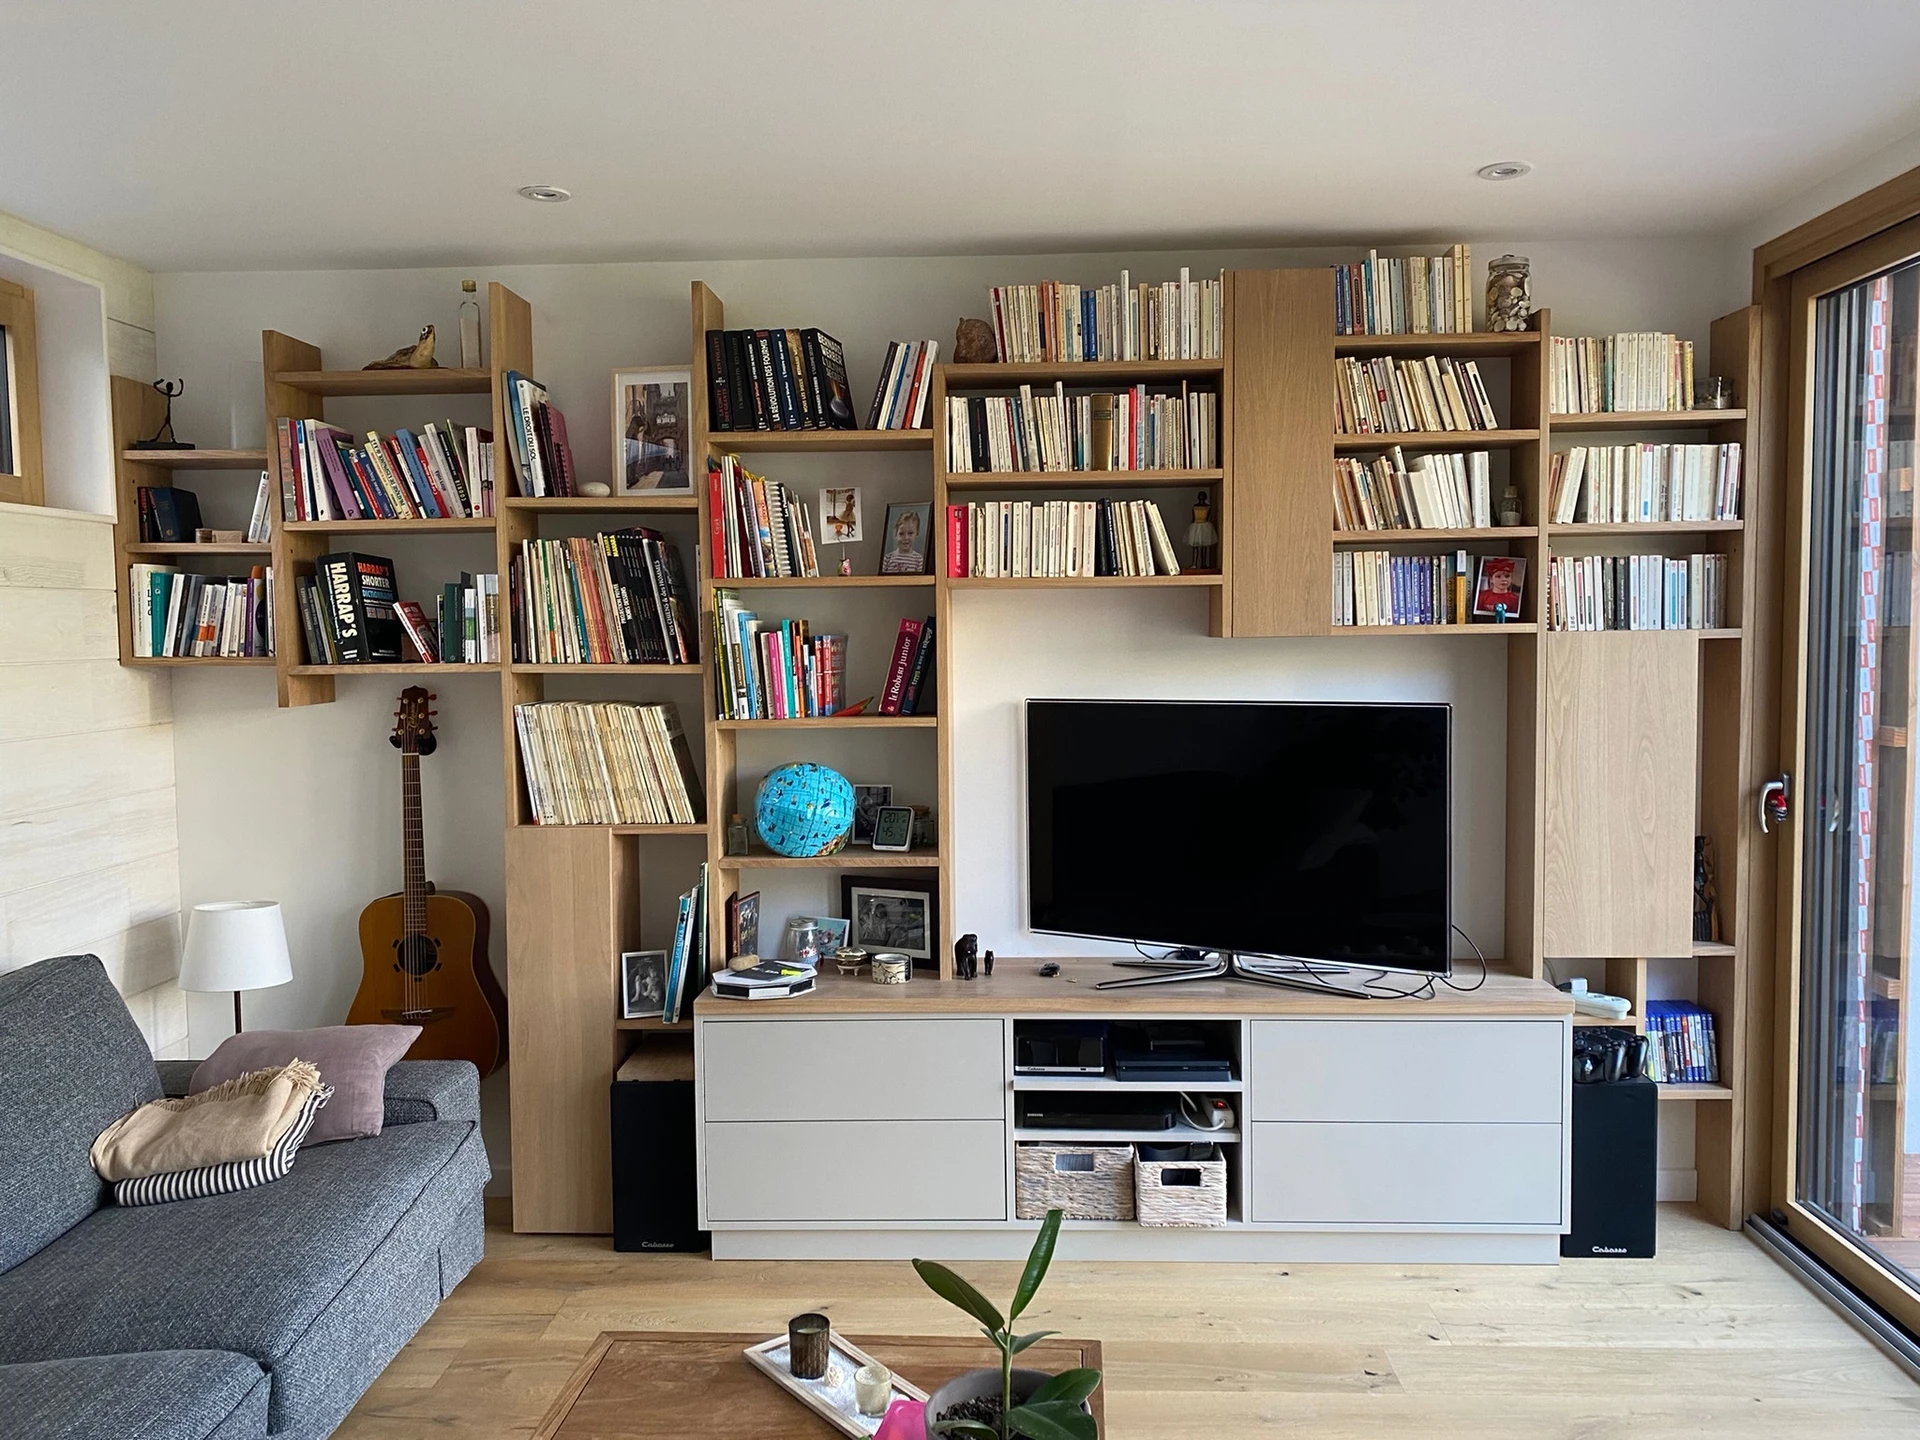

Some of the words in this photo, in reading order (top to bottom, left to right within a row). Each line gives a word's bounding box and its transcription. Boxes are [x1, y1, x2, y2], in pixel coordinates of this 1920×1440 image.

[761, 338, 771, 365] FOURMIS
[817, 332, 842, 356] BERNARD
[820, 344, 843, 366] WERBER
[763, 364, 772, 377] DES
[822, 355, 845, 378] L'ULTIME
[826, 367, 843, 385] SECRET
[766, 376, 780, 413] RÉVOLUTION
[522, 406, 529, 415] LE
[772, 412, 780, 421] LA
[523, 415, 533, 437] DROIT
[527, 436, 535, 448] DU
[528, 447, 536, 461] SOL
[433, 469, 442, 482] voilà
[438, 480, 446, 492] alors
[454, 479, 466, 501] COOKIE
[357, 562, 389, 576] HARRAP'S
[653, 559, 664, 586] HOMMES
[362, 575, 390, 588] SHORTER
[330, 562, 358, 638] HARRAP'S
[620, 586, 629, 606] DESSEINS
[616, 598, 626, 624] PROJECTION
[624, 605, 632, 620] NOIRS
[662, 602, 672, 624] CHIENS
[897, 636, 913, 665] junior
[882, 826, 893, 837] 45
[641, 1241, 675, 1249] Cabasse
